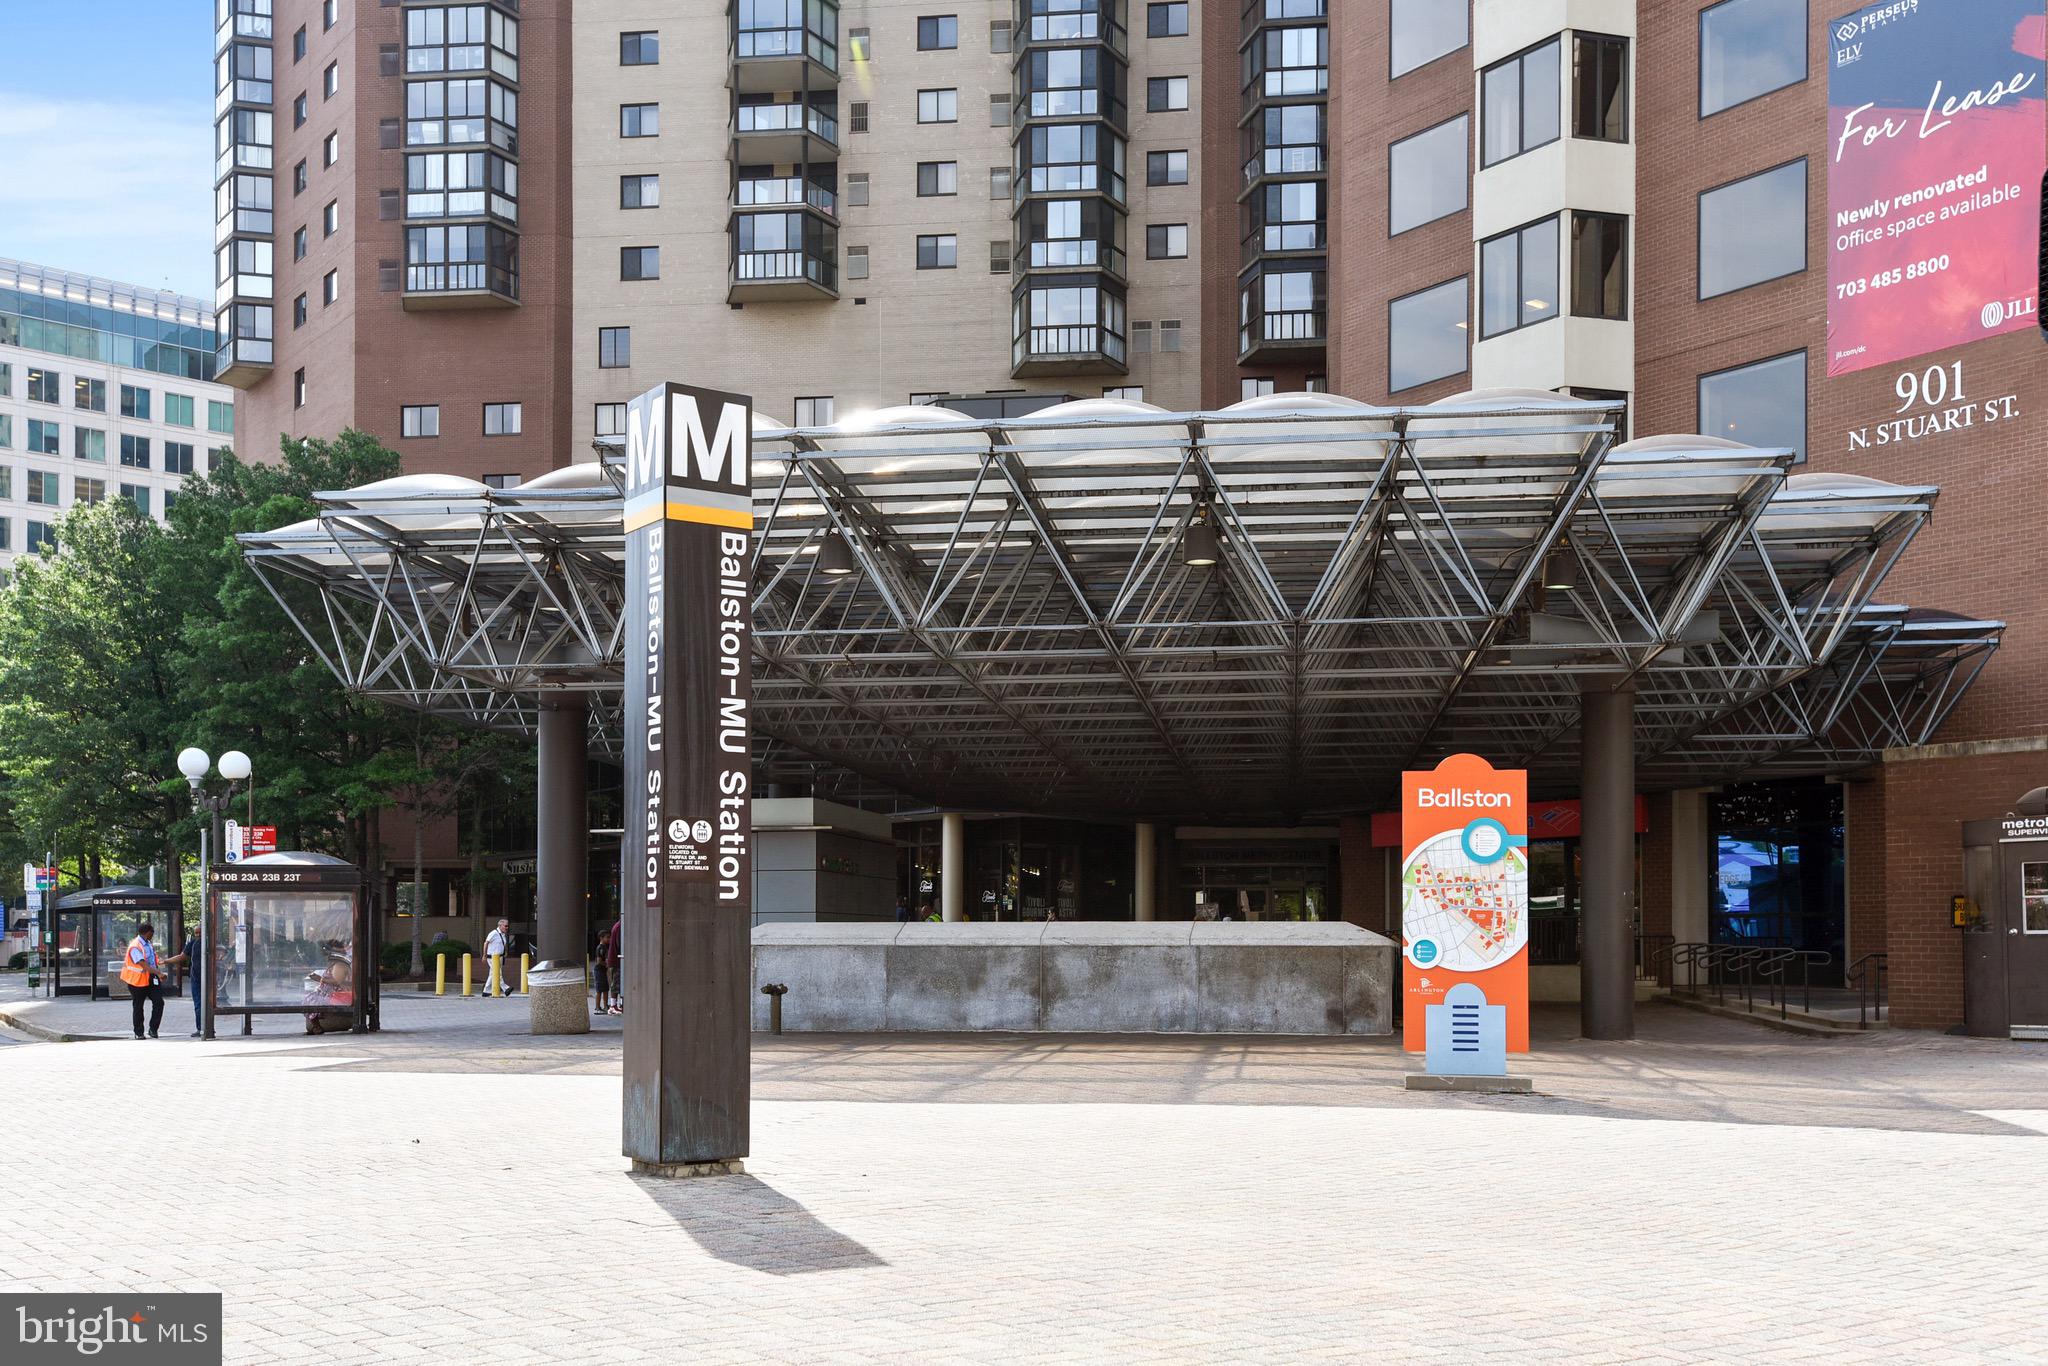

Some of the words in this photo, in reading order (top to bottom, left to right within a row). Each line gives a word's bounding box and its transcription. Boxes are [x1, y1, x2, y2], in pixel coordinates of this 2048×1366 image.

[1861, 0, 1918, 28] PERSEUS
[1861, 7, 1918, 34] REALTY
[1837, 42, 1863, 63] ELV
[1836, 102, 1907, 162] For
[1919, 72, 2036, 139] Lease
[1837, 199, 1890, 227] Newly
[1894, 165, 1987, 210] renovated
[1837, 229, 1883, 251] Office
[1887, 210, 1935, 238] space
[1939, 183, 2021, 221] available
[1836, 278, 1867, 299] 703
[1870, 268, 1902, 289] 485
[1906, 254, 1950, 280] 8800
[2004, 296, 2036, 319] JLL
[1835, 345, 1867, 360] jll.com/dc
[1895, 360, 1966, 414] 901
[627, 395, 664, 491] M
[671, 392, 747, 487] M
[1848, 428, 1871, 451] N.
[1876, 404, 1977, 446] STUART
[1984, 395, 2020, 423] ST.
[648, 526, 662, 752] Ballston-MU
[719, 531, 747, 754] Ballston-MU
[1417, 787, 1512, 808] Ballston
[647, 769, 662, 901] Station
[719, 769, 747, 900] Station
